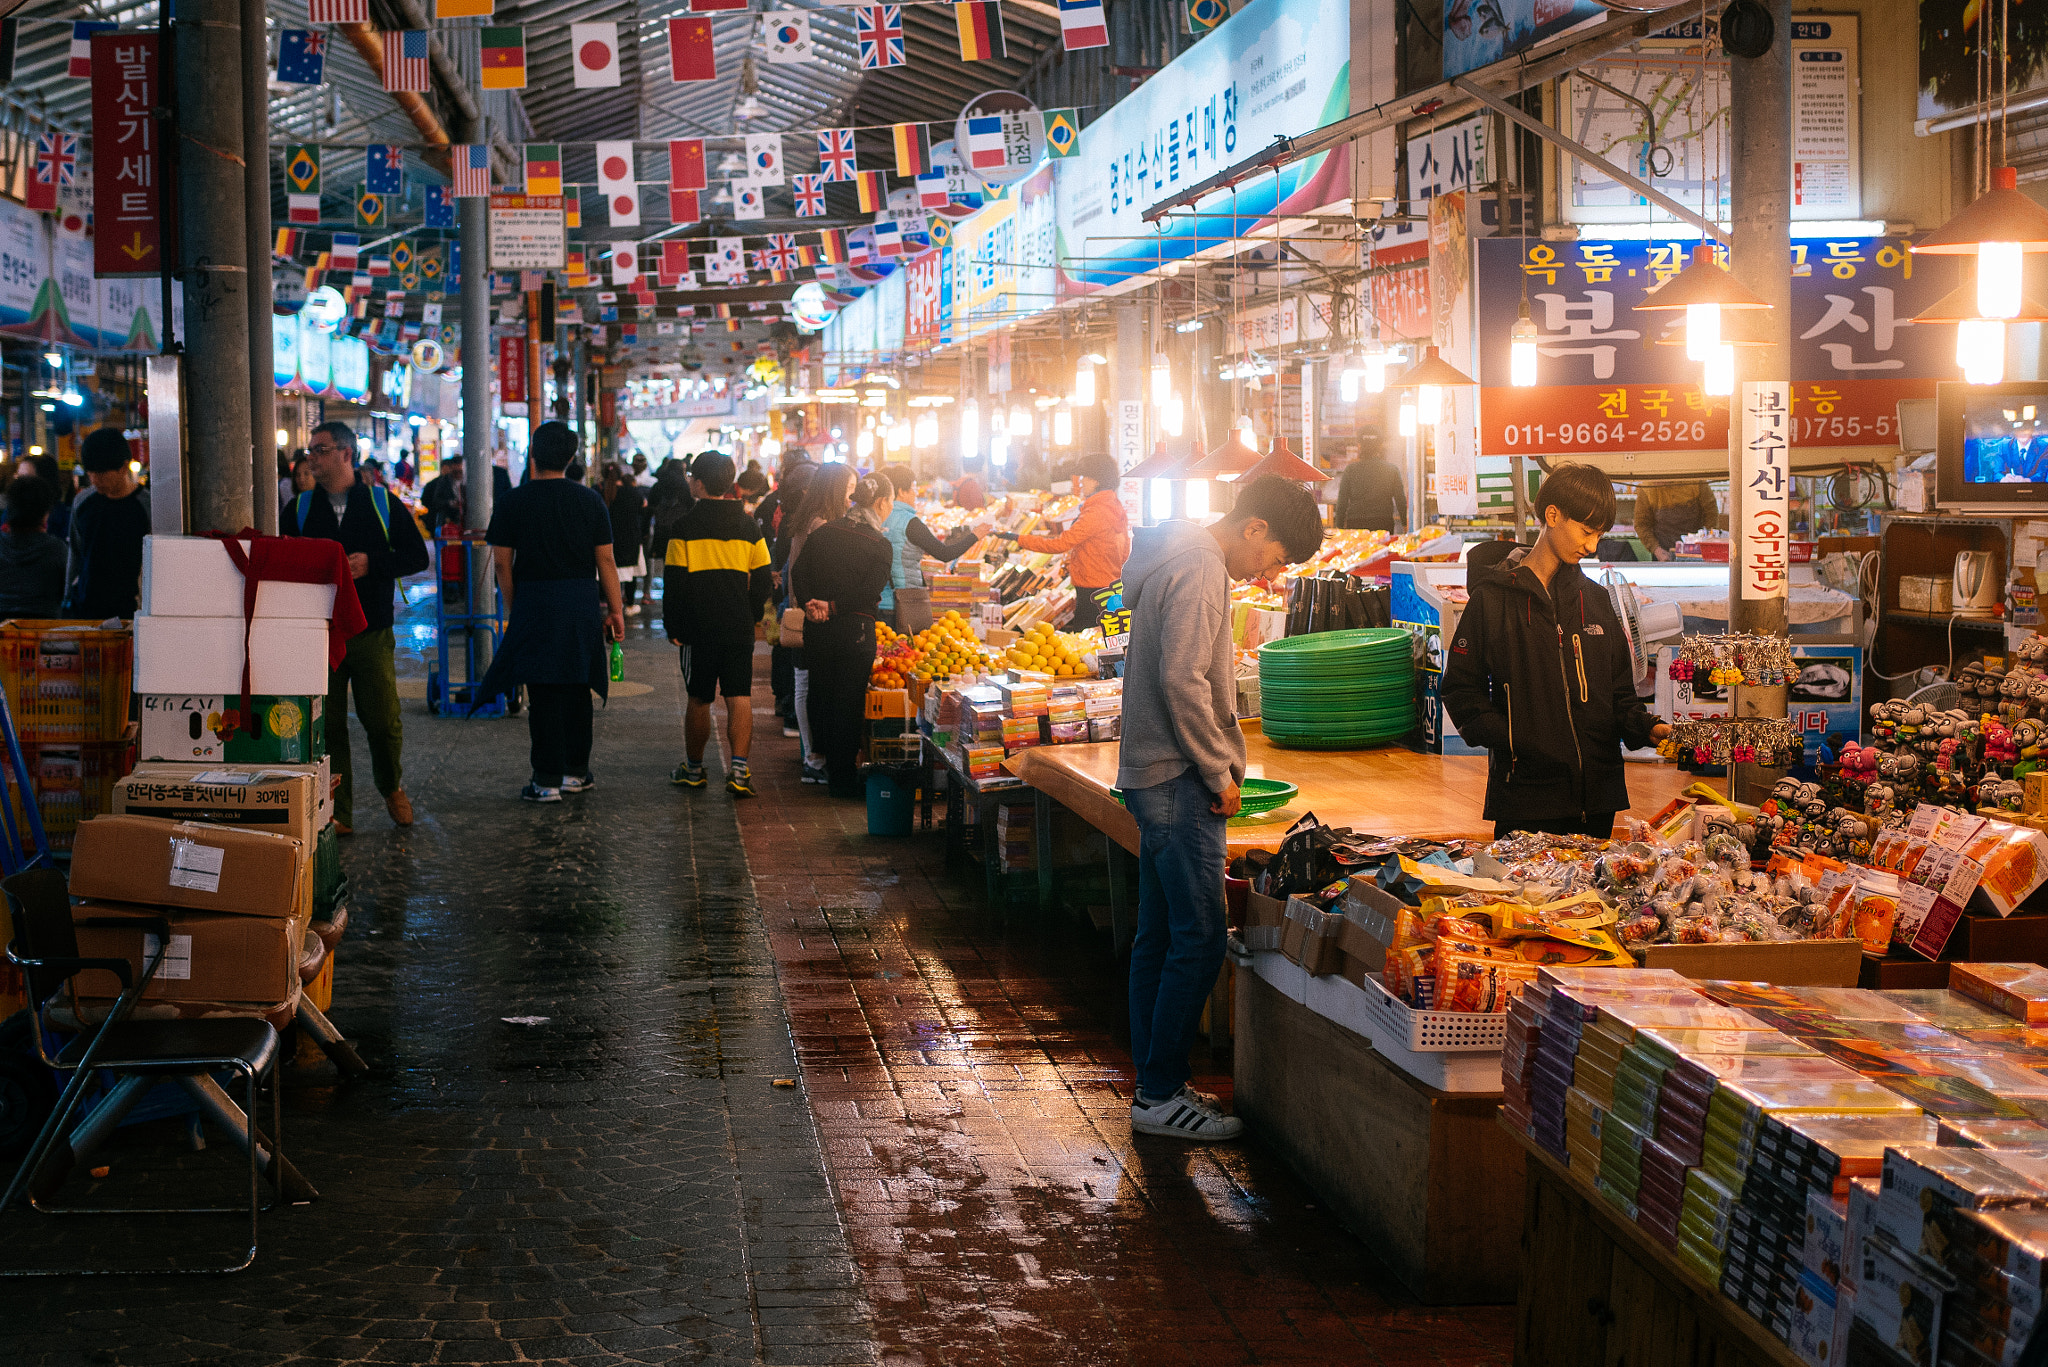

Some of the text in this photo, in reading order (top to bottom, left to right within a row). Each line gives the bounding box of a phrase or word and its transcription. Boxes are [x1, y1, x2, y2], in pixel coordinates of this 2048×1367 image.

[1798, 25, 1822, 37] 안내
[115, 44, 154, 222] 발신기세트
[1109, 80, 1240, 215] 명진수산물직매장
[948, 179, 967, 192] 21
[904, 221, 920, 232] 25
[1533, 286, 1916, 380] 복산
[1504, 420, 1706, 447] 011-9664-2526
[1748, 391, 1787, 593] 복수산(옥돔)
[256, 789, 290, 805] 30개입
